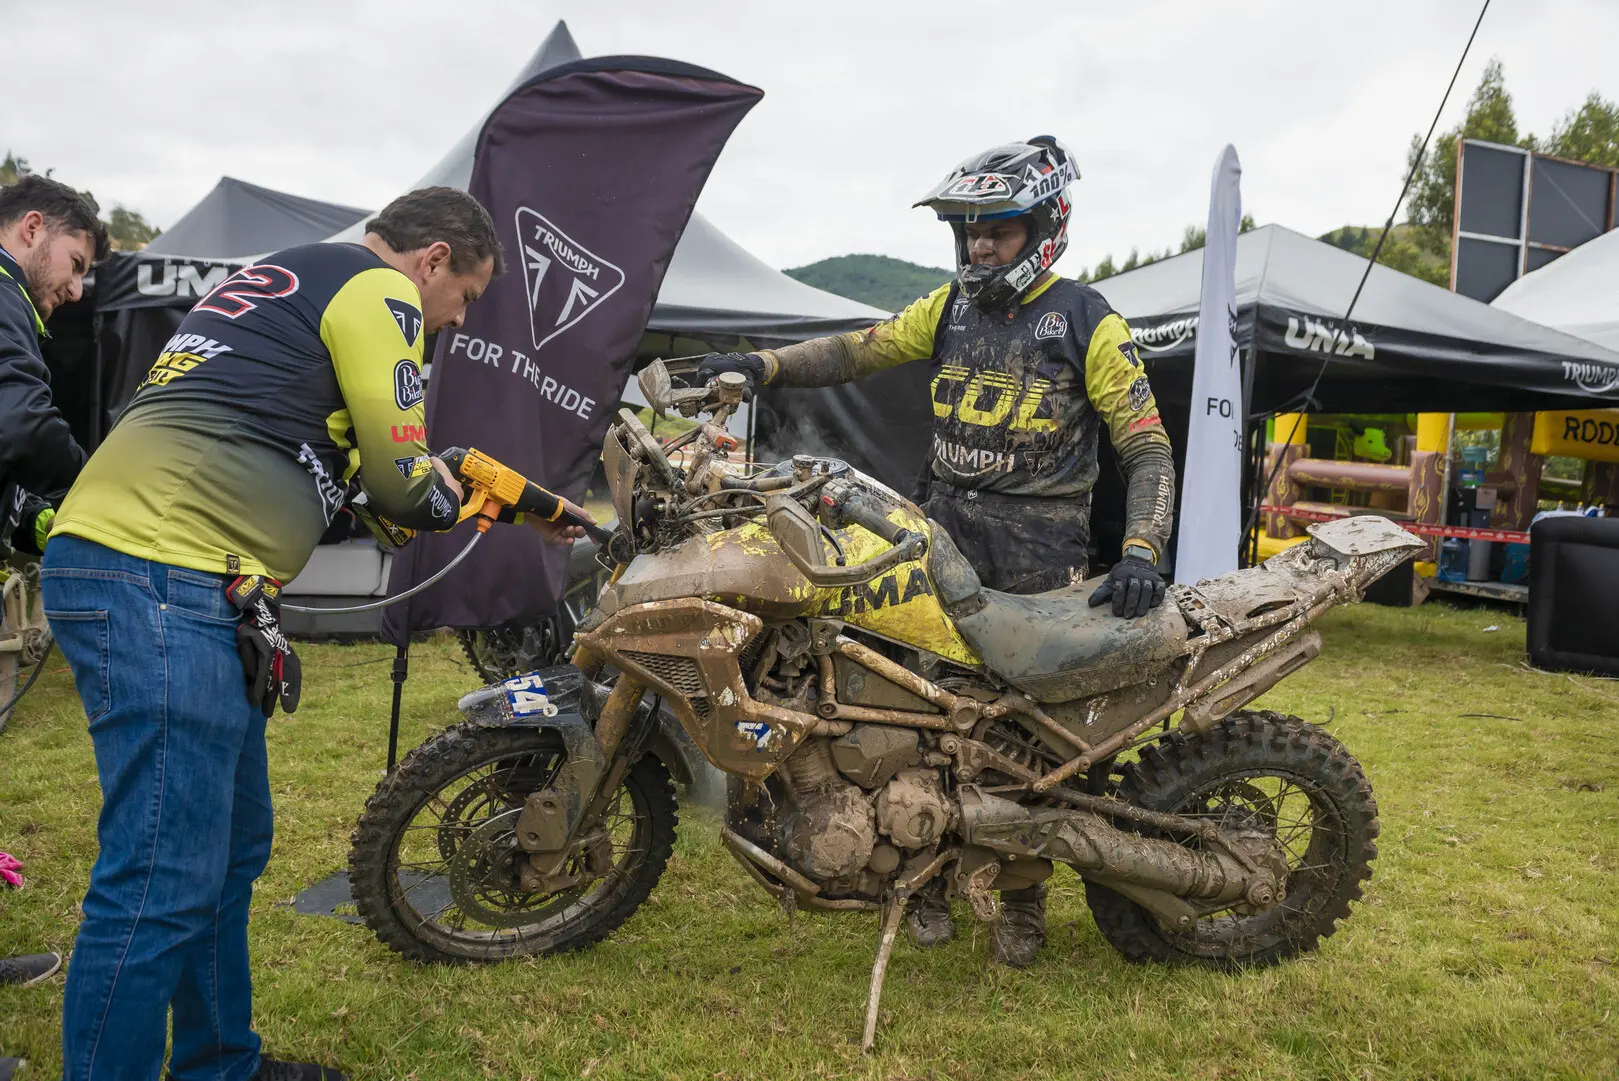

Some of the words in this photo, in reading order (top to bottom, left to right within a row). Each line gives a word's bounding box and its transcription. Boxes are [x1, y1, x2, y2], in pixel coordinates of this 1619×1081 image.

[1029, 164, 1073, 199] 100%
[534, 225, 600, 281] TRIUMPH
[137, 264, 229, 297] UM
[192, 264, 300, 319] 2
[1045, 314, 1065, 332] Big
[1130, 316, 1200, 352] RIUMPH
[1285, 317, 1375, 360] UMA
[450, 333, 503, 368] FOR
[511, 350, 541, 390] THE
[540, 377, 596, 420] RIDE
[1561, 361, 1619, 392] TRIUMP
[930, 364, 1058, 433] COL
[1206, 397, 1234, 420] FO
[391, 425, 428, 443] UM
